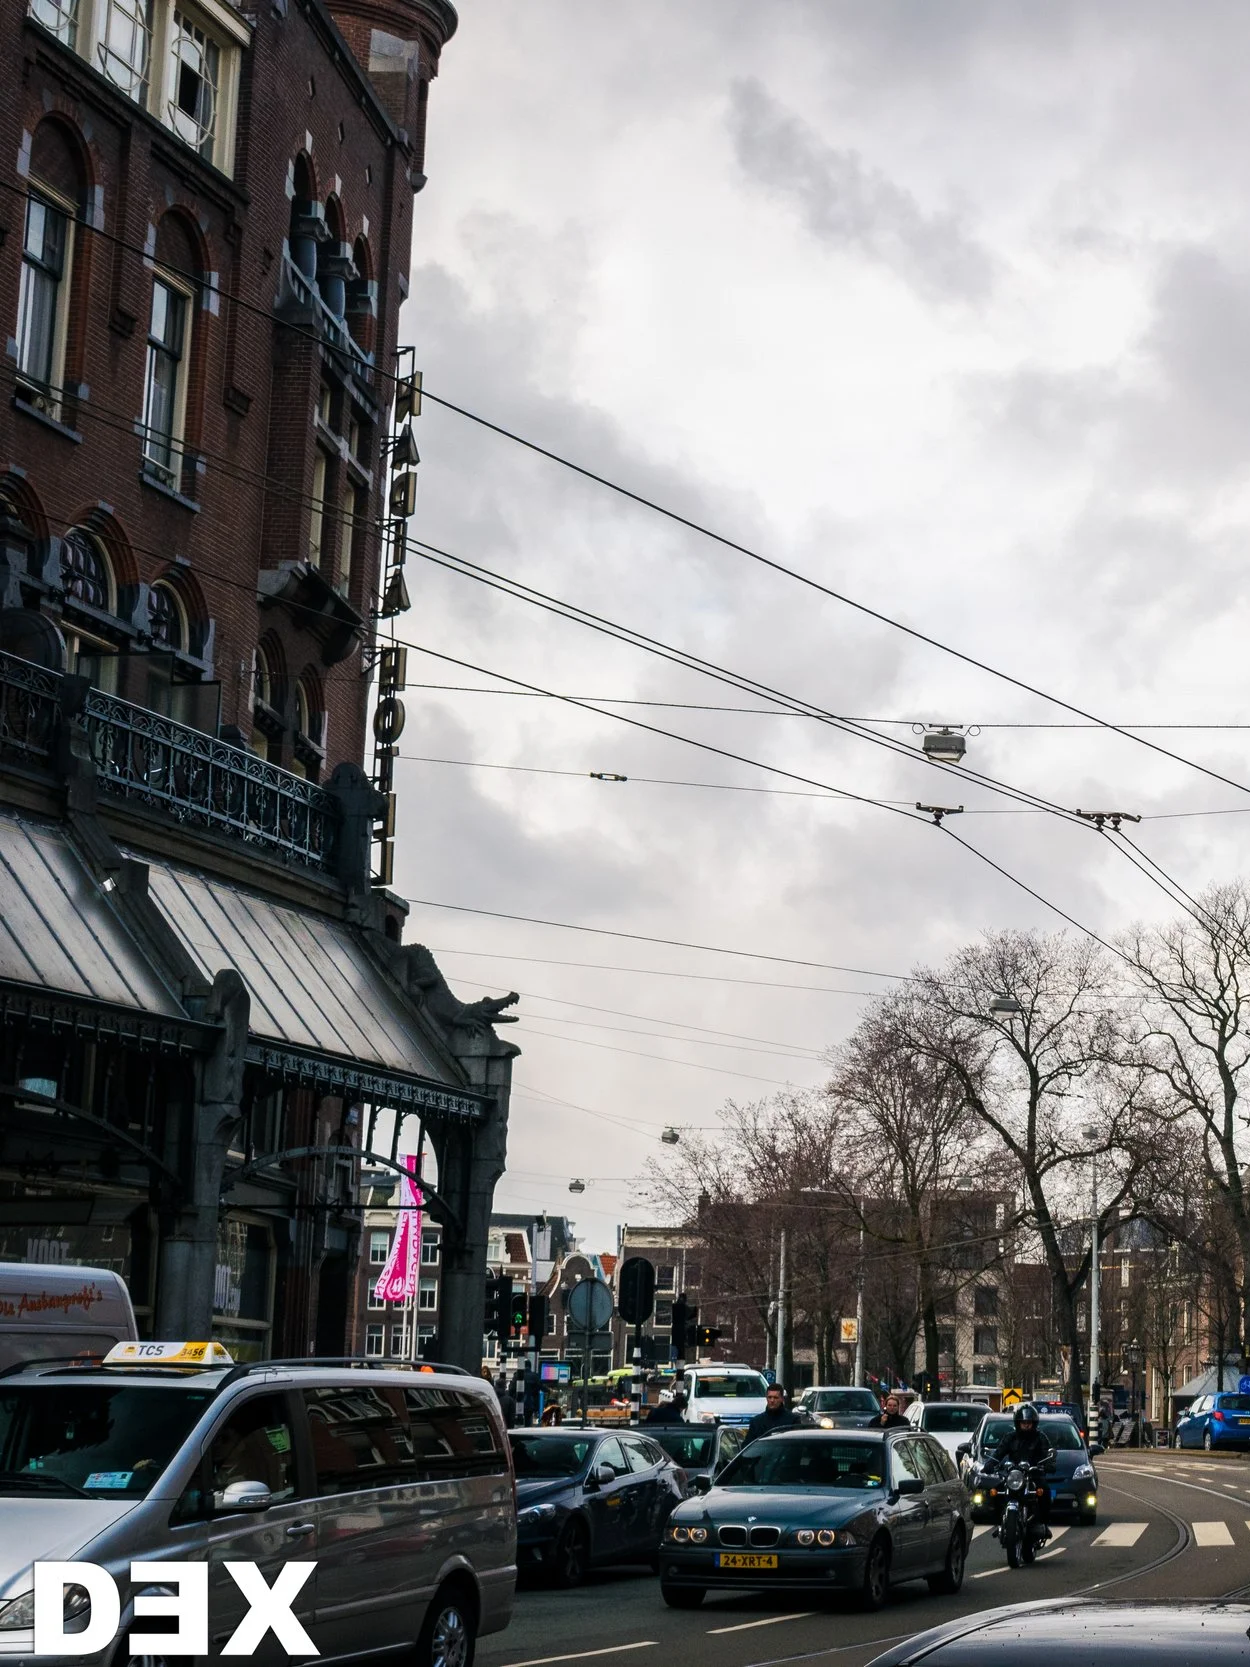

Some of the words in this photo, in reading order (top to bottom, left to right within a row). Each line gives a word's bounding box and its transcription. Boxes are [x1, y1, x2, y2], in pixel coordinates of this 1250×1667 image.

[138, 1345, 164, 1356] TCS
[180, 1347, 205, 1357] 3456
[724, 1555, 773, 1567] 24-XRT-4
